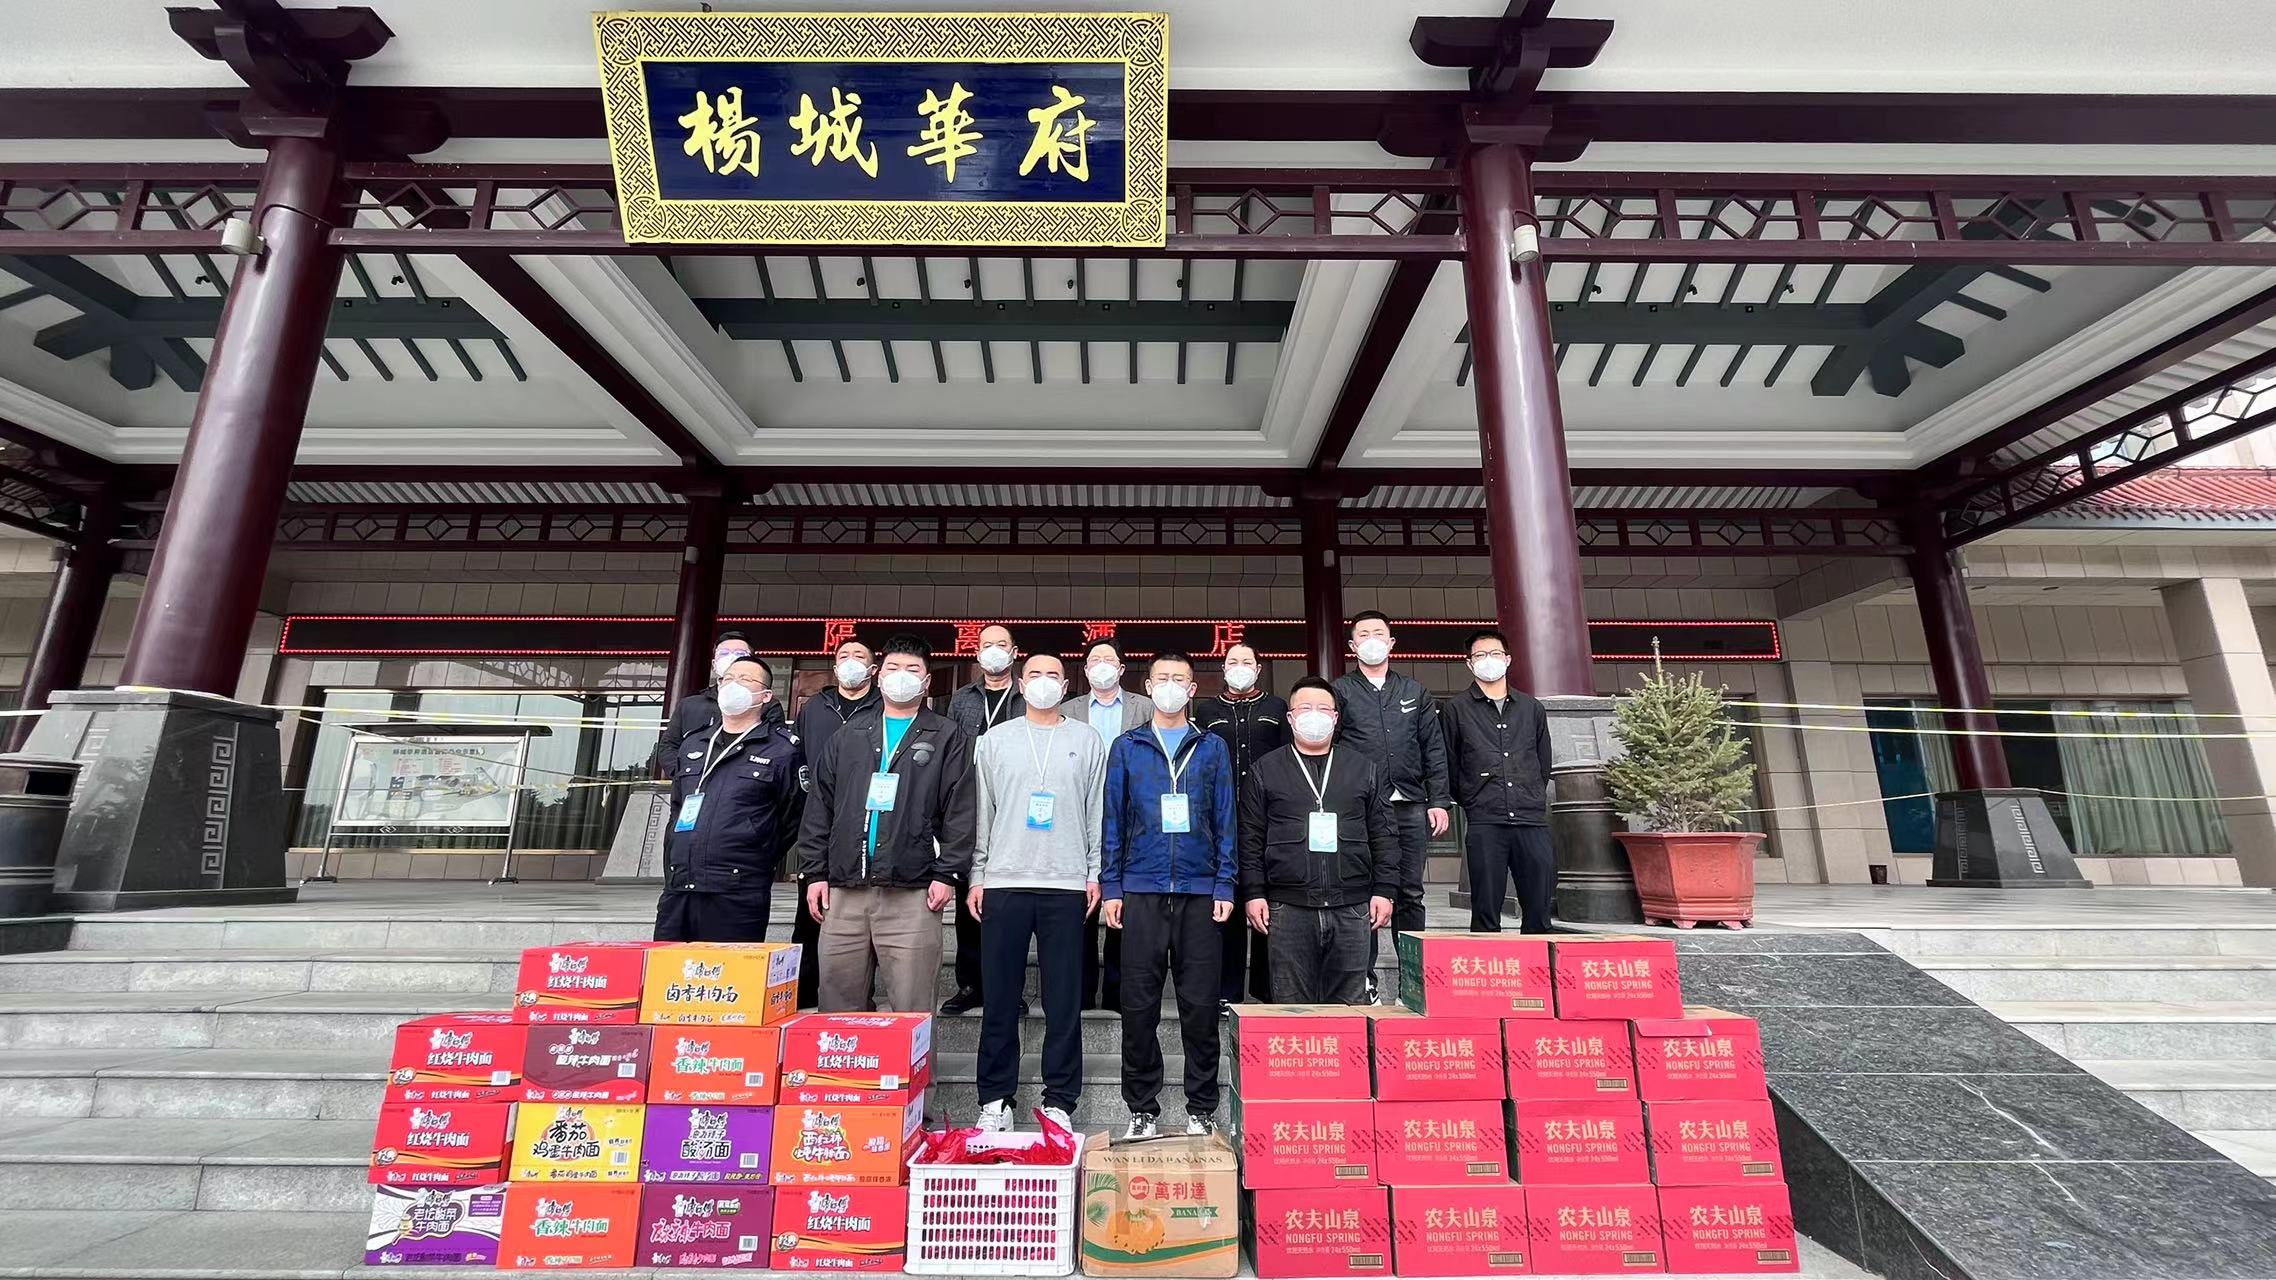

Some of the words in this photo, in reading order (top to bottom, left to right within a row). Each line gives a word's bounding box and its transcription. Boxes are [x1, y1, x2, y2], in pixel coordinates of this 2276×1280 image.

[678, 82, 1098, 183] 楊城華府
[1451, 957, 1521, 975] 农夫山泉
[1582, 960, 1651, 978] 农夫山泉
[548, 975, 607, 988] 红烧牛肉面
[1452, 978, 1487, 987] NONGFU
[1490, 978, 1522, 987] SPRING
[1584, 980, 1618, 990] NONGFU
[1621, 980, 1653, 990] SPRING
[666, 983, 738, 1002] 卤香牛肉面
[1268, 1036, 1339, 1055] 农夫山泉
[1404, 1038, 1475, 1057] 农夫山泉
[1535, 1036, 1604, 1056] 农夫山泉
[1663, 1038, 1734, 1057] 农夫山泉
[427, 1052, 493, 1065] 红烧牛肉面
[675, 1058, 744, 1074] 香辣牛肉面
[817, 1055, 879, 1069] 红烧牛肉面
[1268, 1058, 1304, 1067] NONGFU
[1307, 1057, 1339, 1067] SPRING
[1405, 1060, 1440, 1070] NONGFU
[1444, 1060, 1476, 1070] SPRING
[1536, 1059, 1571, 1068] NONGFU
[1574, 1059, 1606, 1068] SPRING
[1665, 1060, 1700, 1070] NONGFU
[1703, 1060, 1735, 1070] SPRING
[549, 1120, 587, 1143] 番茄
[1272, 1121, 1346, 1141] 农夫山泉
[1404, 1119, 1477, 1139] 农夫山泉
[1544, 1120, 1616, 1140] 农夫山泉
[1679, 1120, 1750, 1140] 农夫山泉
[407, 1132, 469, 1146] 红烧牛肉面
[1405, 1142, 1441, 1152] NONGFU
[1444, 1142, 1477, 1151] SPRING
[532, 1141, 600, 1158] 鸡蛋牛肉面
[682, 1141, 730, 1158] 酸汤面
[1273, 1145, 1310, 1155] NONGFU
[1313, 1144, 1346, 1154] SPRING
[1547, 1143, 1582, 1153] NONGFU
[1585, 1143, 1618, 1152] SPRING
[1682, 1143, 1716, 1153] NONGFU
[1719, 1142, 1751, 1152] SPRING
[1166, 1156, 1223, 1164] BANANAS
[1154, 1181, 1207, 1200] 萬利達
[413, 1208, 458, 1221] 老坛酸菜
[1285, 1208, 1360, 1230] 农夫山泉
[1425, 1207, 1498, 1228] 农夫山泉
[1557, 1206, 1632, 1227] 农夫山泉
[1689, 1205, 1763, 1226] 农夫山泉
[414, 1221, 451, 1232] 牛肉面
[536, 1219, 609, 1237] 香辣牛肉面
[651, 1218, 731, 1244] 麻辣牛肉面
[807, 1217, 871, 1231] 红烧牛肉面
[1285, 1233, 1323, 1243] NONGFU
[1327, 1233, 1361, 1243] SPRING
[1426, 1232, 1462, 1242] NONGFU
[1466, 1231, 1499, 1241] SPRING
[1560, 1231, 1596, 1240] NONGFU
[1600, 1231, 1632, 1240] SPRING
[1693, 1229, 1729, 1239] NONGFU
[1733, 1229, 1766, 1239] SPRING
